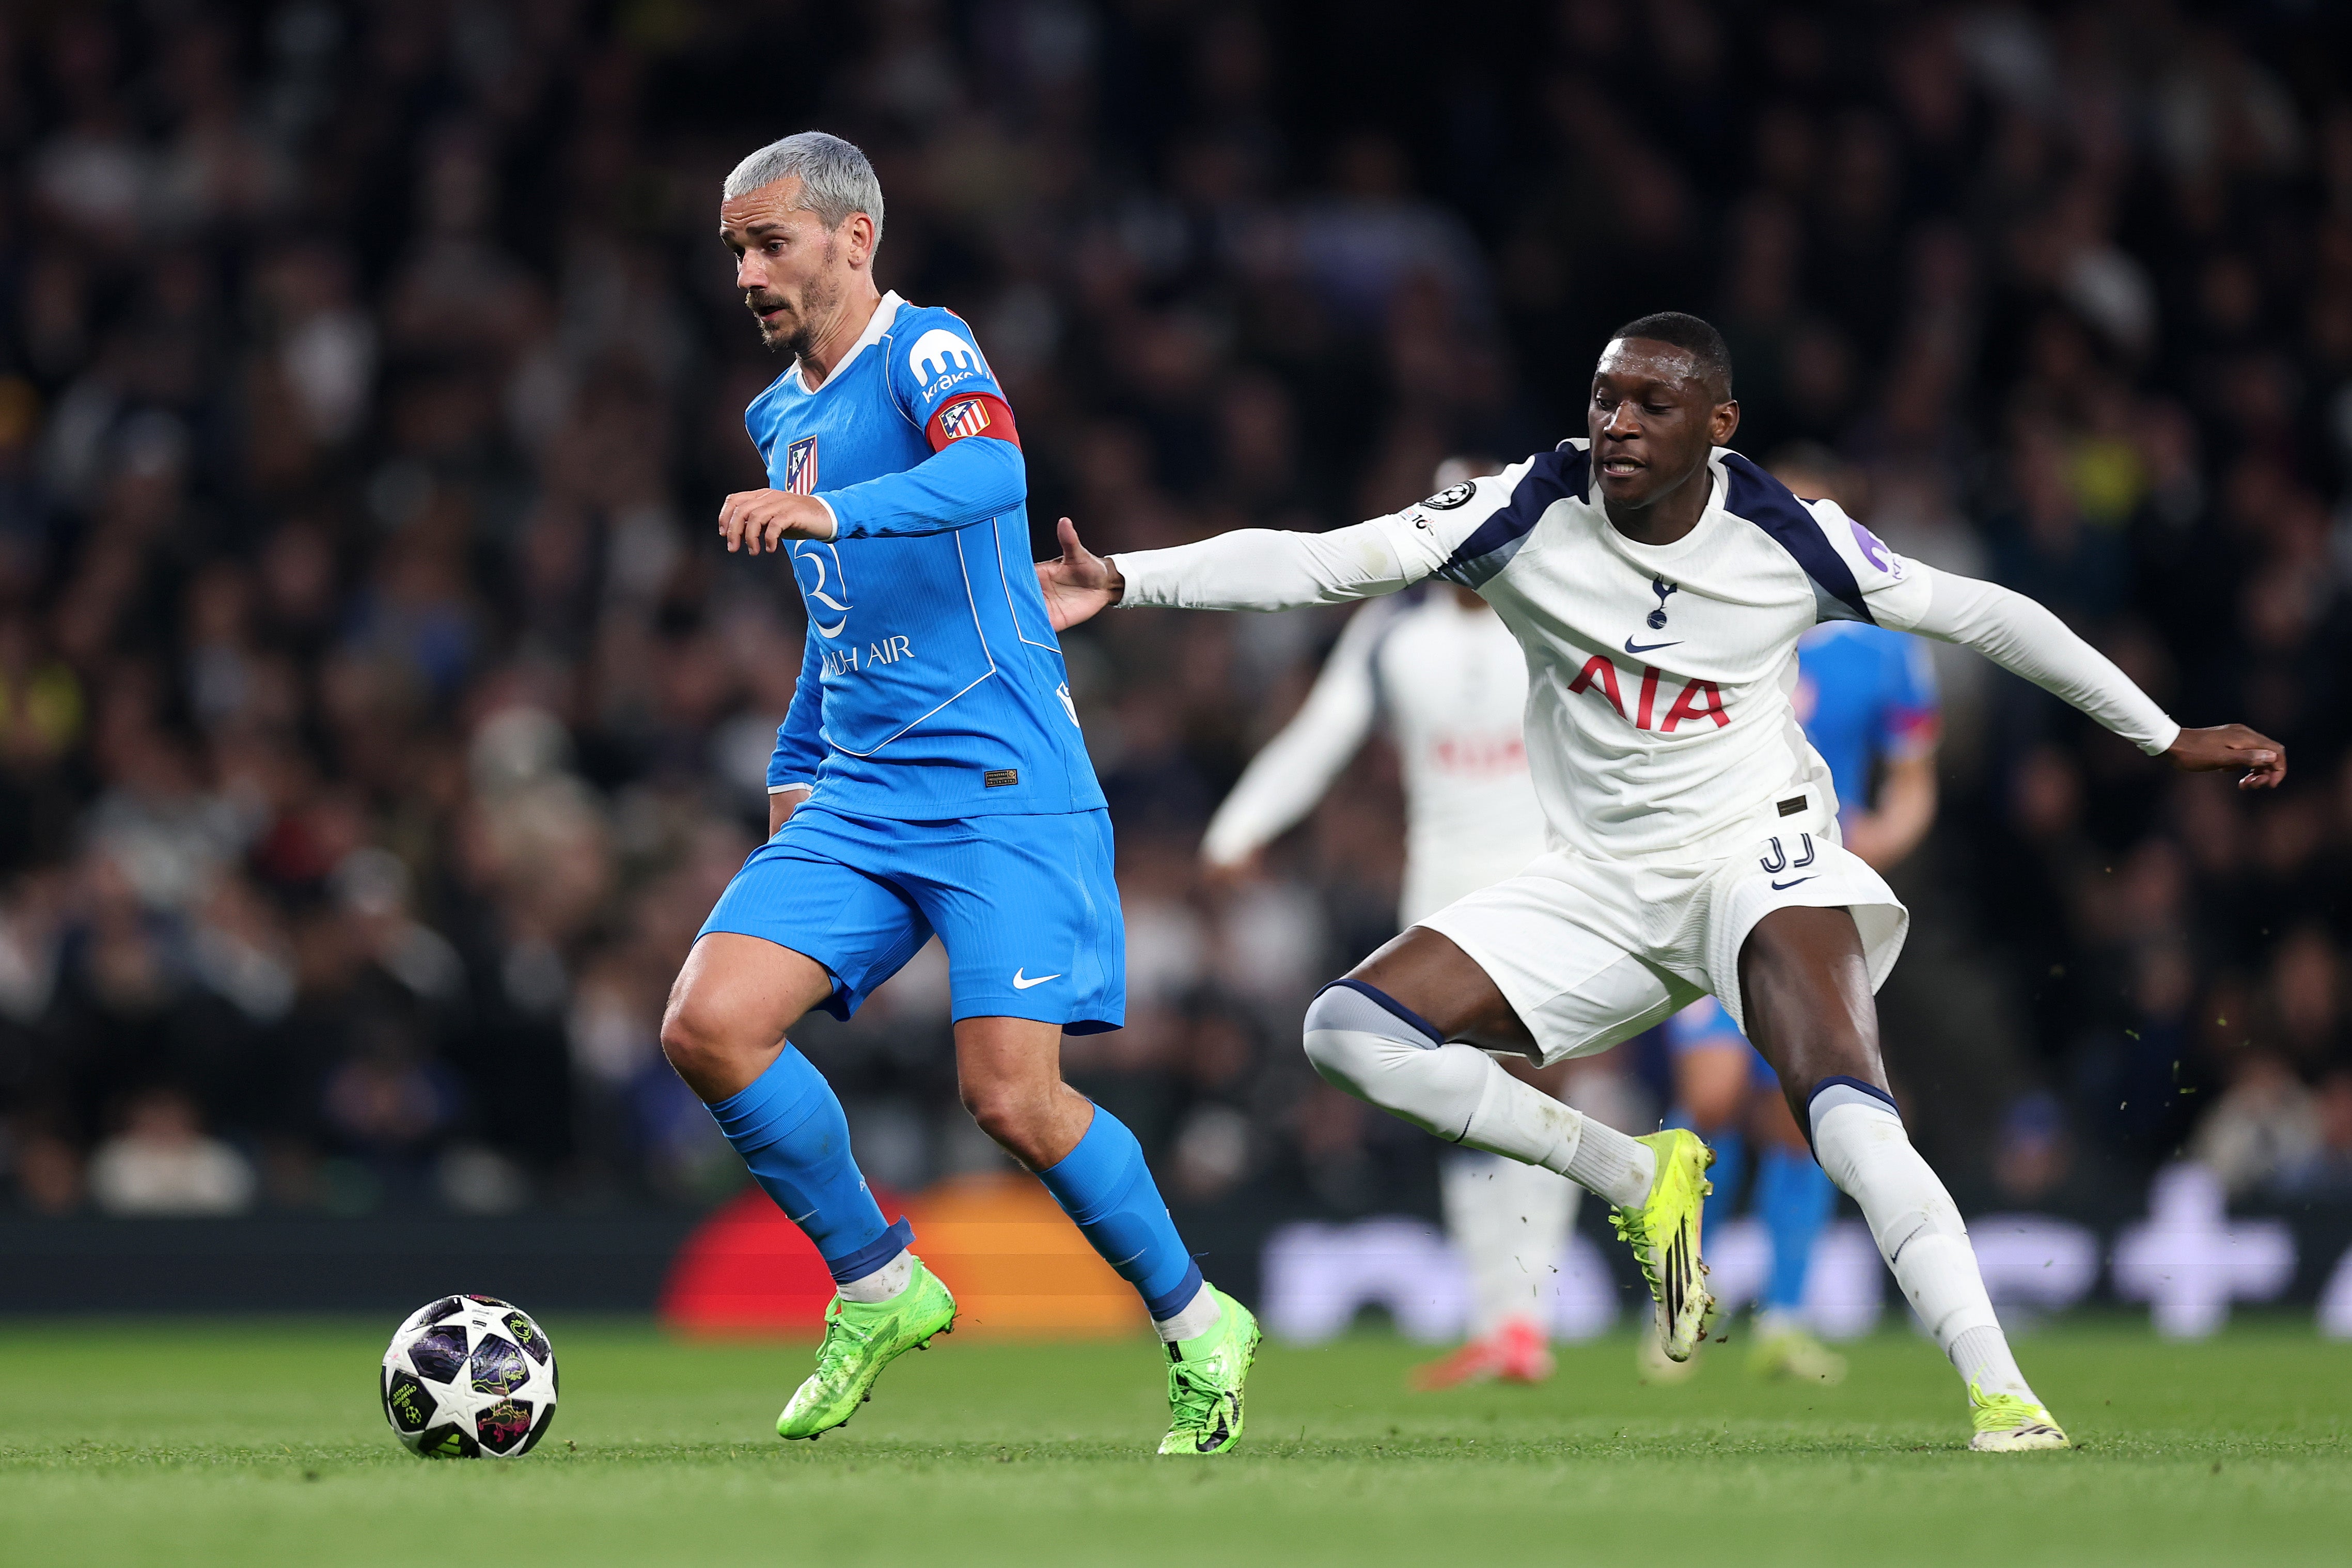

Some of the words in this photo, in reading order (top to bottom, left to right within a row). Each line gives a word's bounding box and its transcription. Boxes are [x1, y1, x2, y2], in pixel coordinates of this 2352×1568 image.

[822, 647, 859, 676] YADH
[867, 635, 915, 668] AIR
[1567, 654, 1731, 732] AIA
